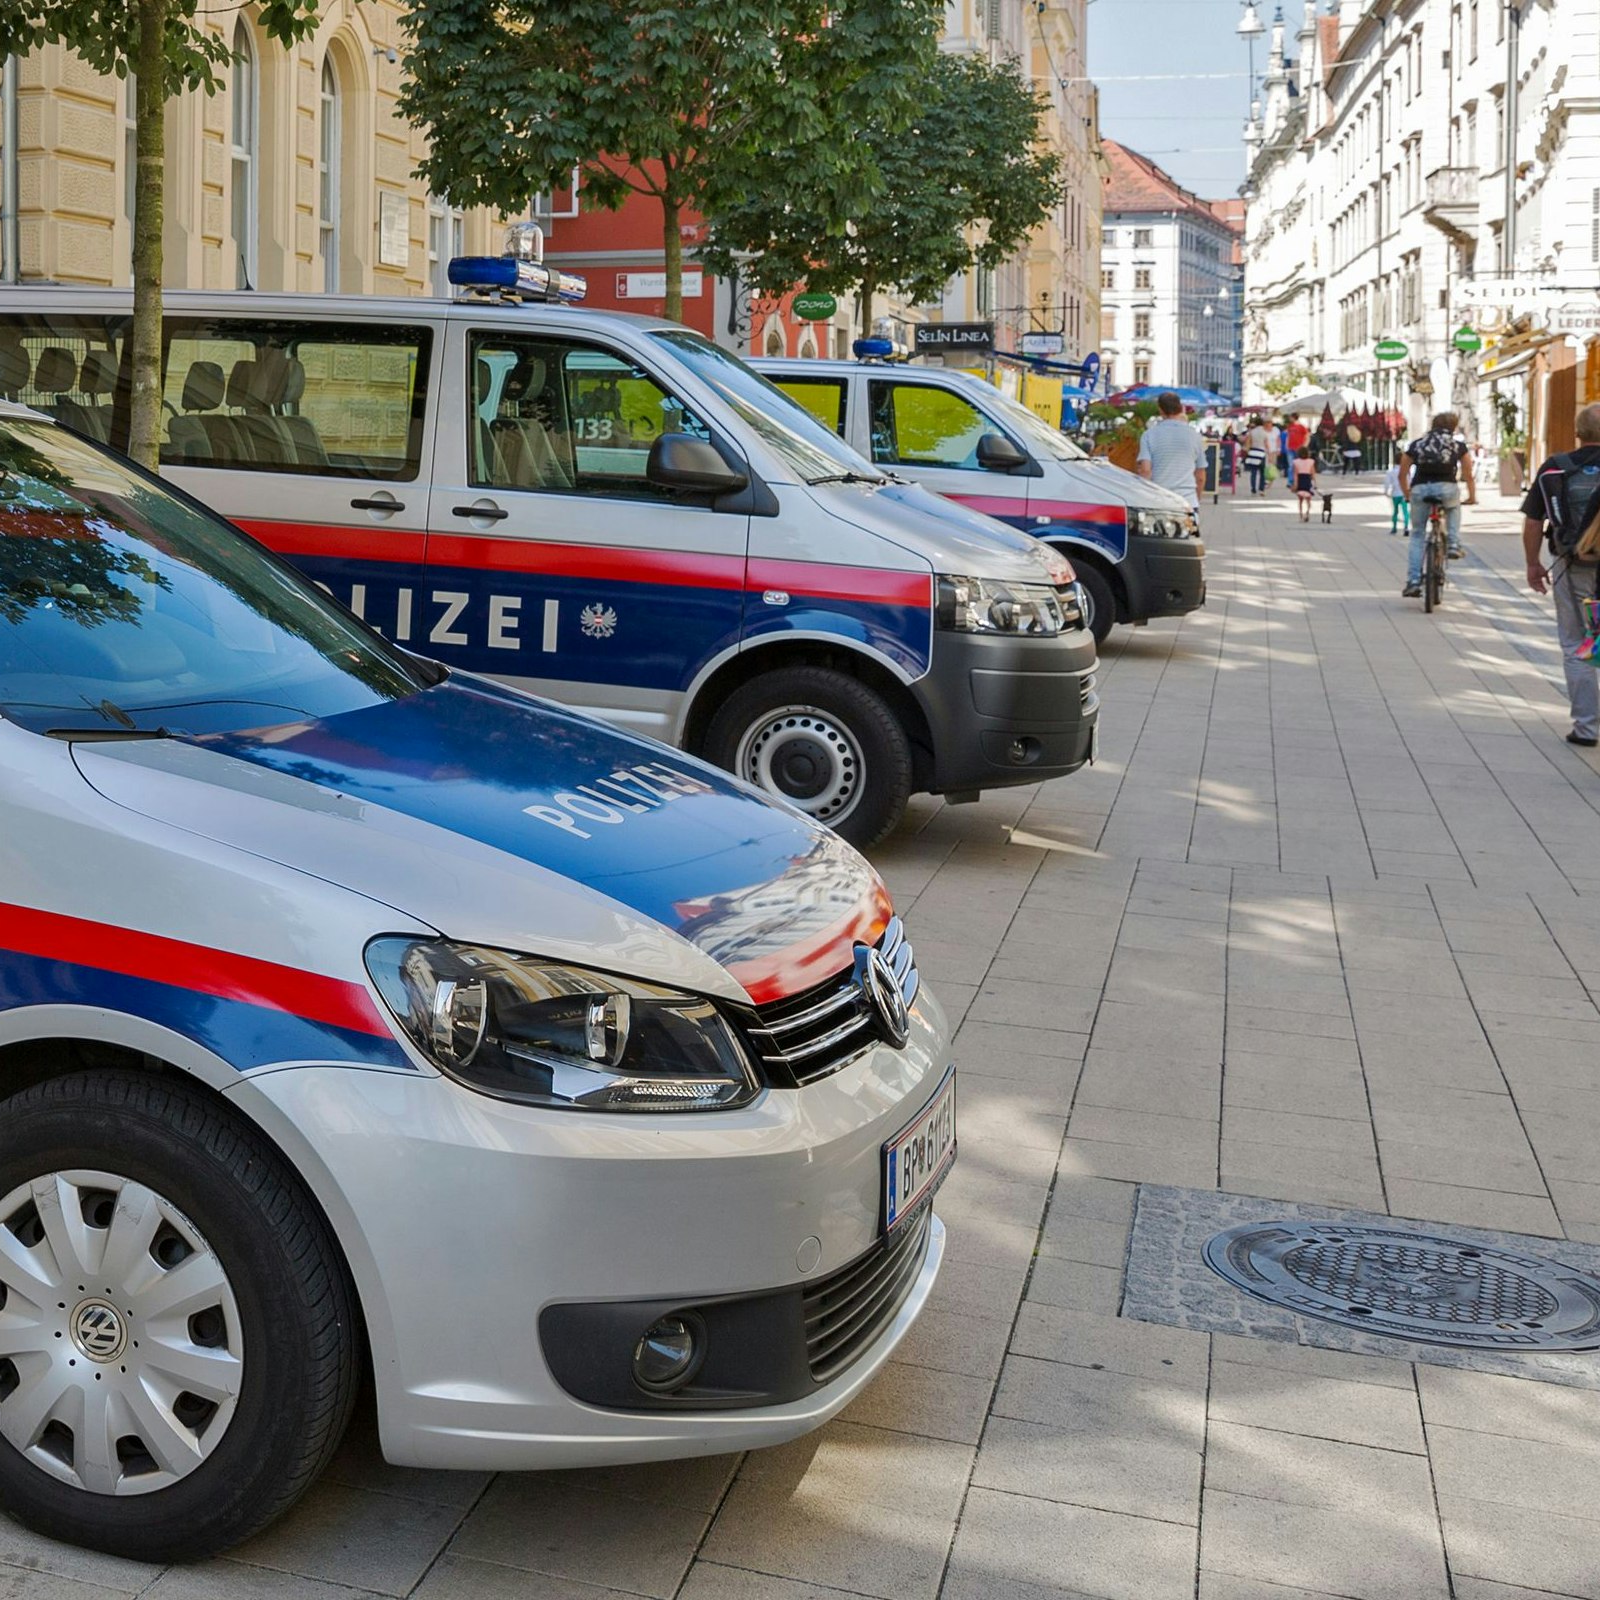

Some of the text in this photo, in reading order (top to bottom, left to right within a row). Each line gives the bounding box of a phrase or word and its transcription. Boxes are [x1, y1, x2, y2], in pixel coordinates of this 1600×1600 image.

[575, 417, 613, 440] 133
[313, 580, 560, 653] LIZEI
[522, 762, 712, 839] POLIZEI
[903, 1134, 919, 1200] BP
